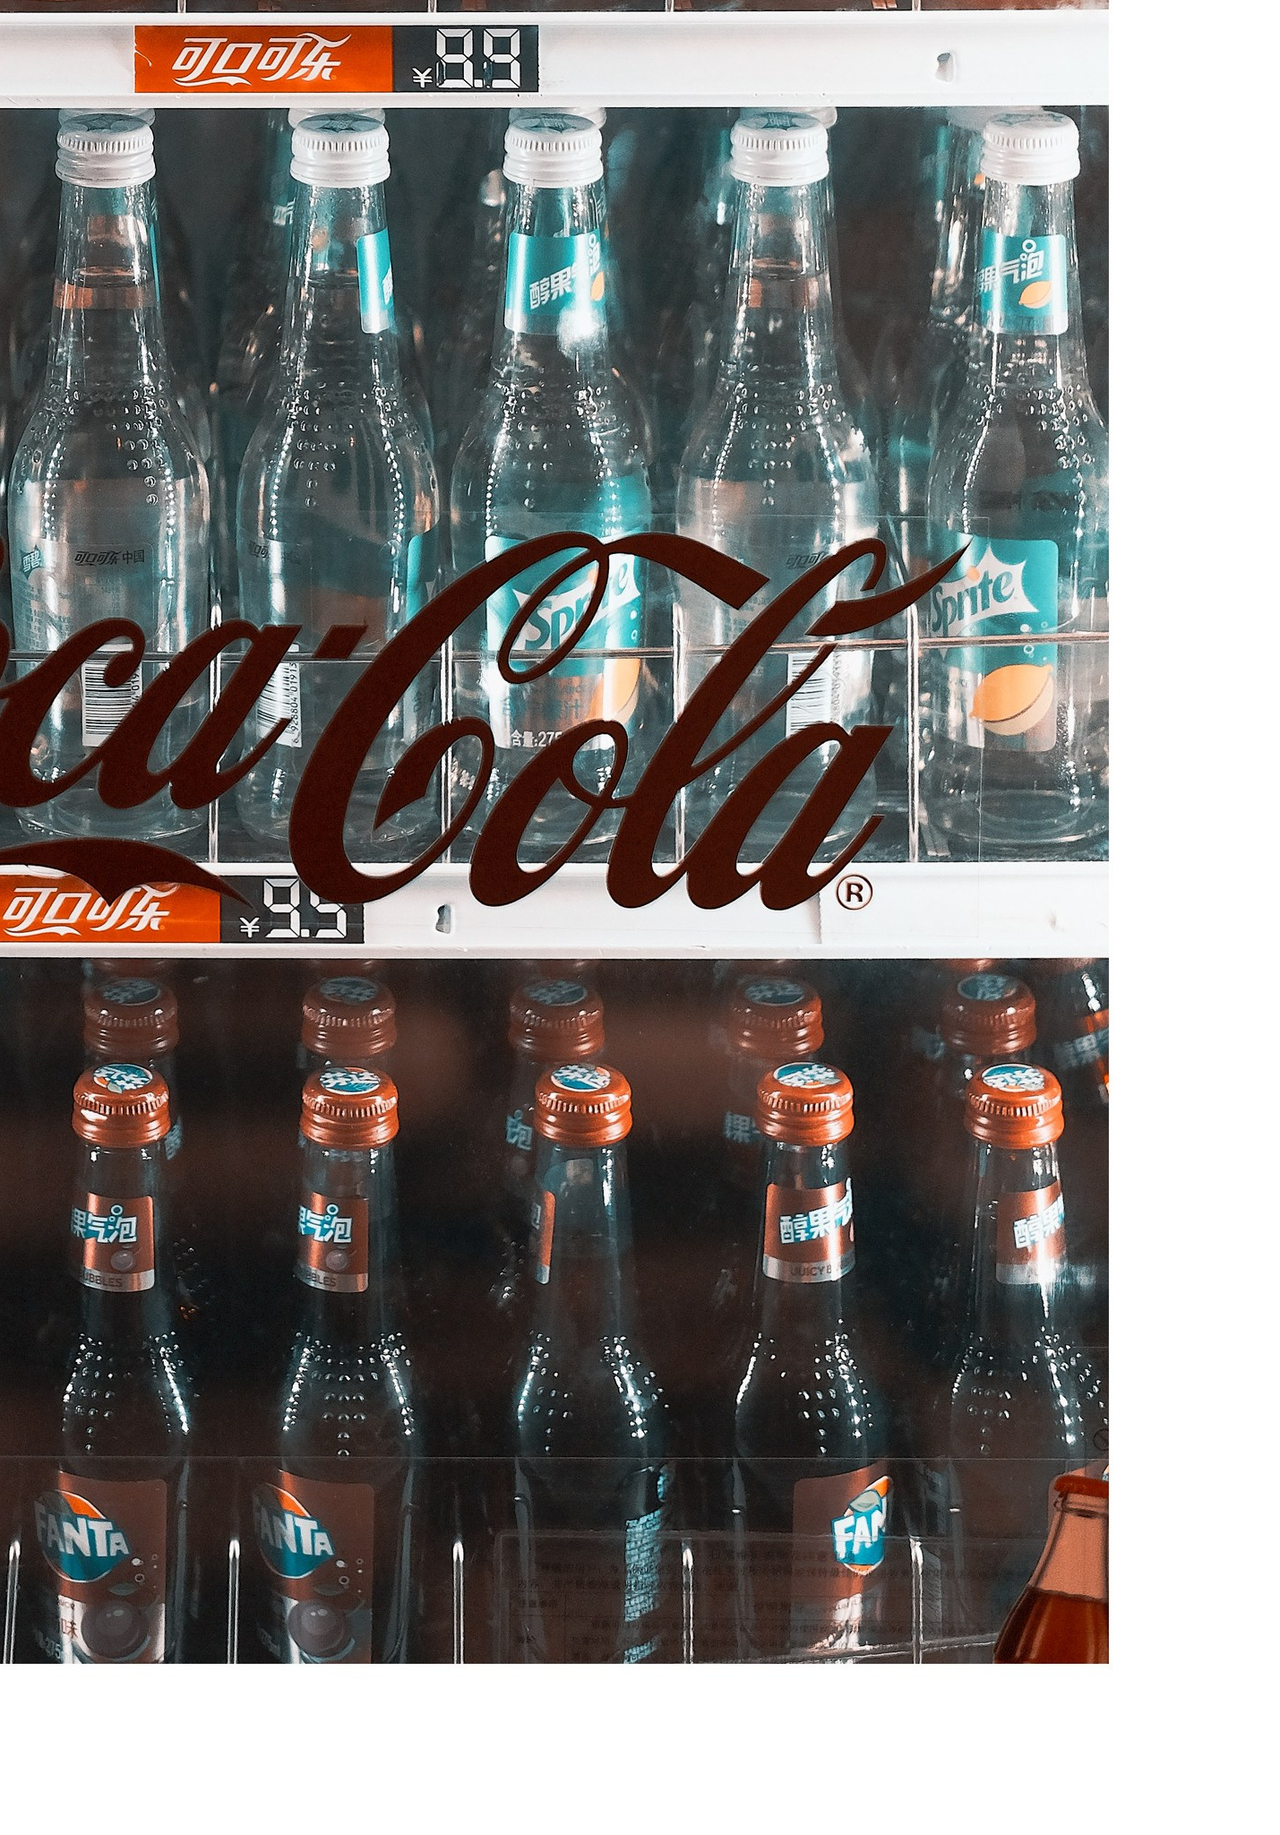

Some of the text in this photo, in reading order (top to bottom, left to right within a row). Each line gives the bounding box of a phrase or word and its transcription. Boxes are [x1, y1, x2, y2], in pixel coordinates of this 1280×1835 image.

[170, 33, 352, 87] 可口可乐
[74, 548, 145, 566] 可口可乐中国
[524, 561, 630, 652] Spre
[932, 567, 1016, 637] Sprite
[509, 729, 563, 749] 含量:275
[779, 1191, 854, 1245] 醇果气
[34, 1501, 130, 1556] FANTA
[254, 1500, 336, 1557] ANTA
